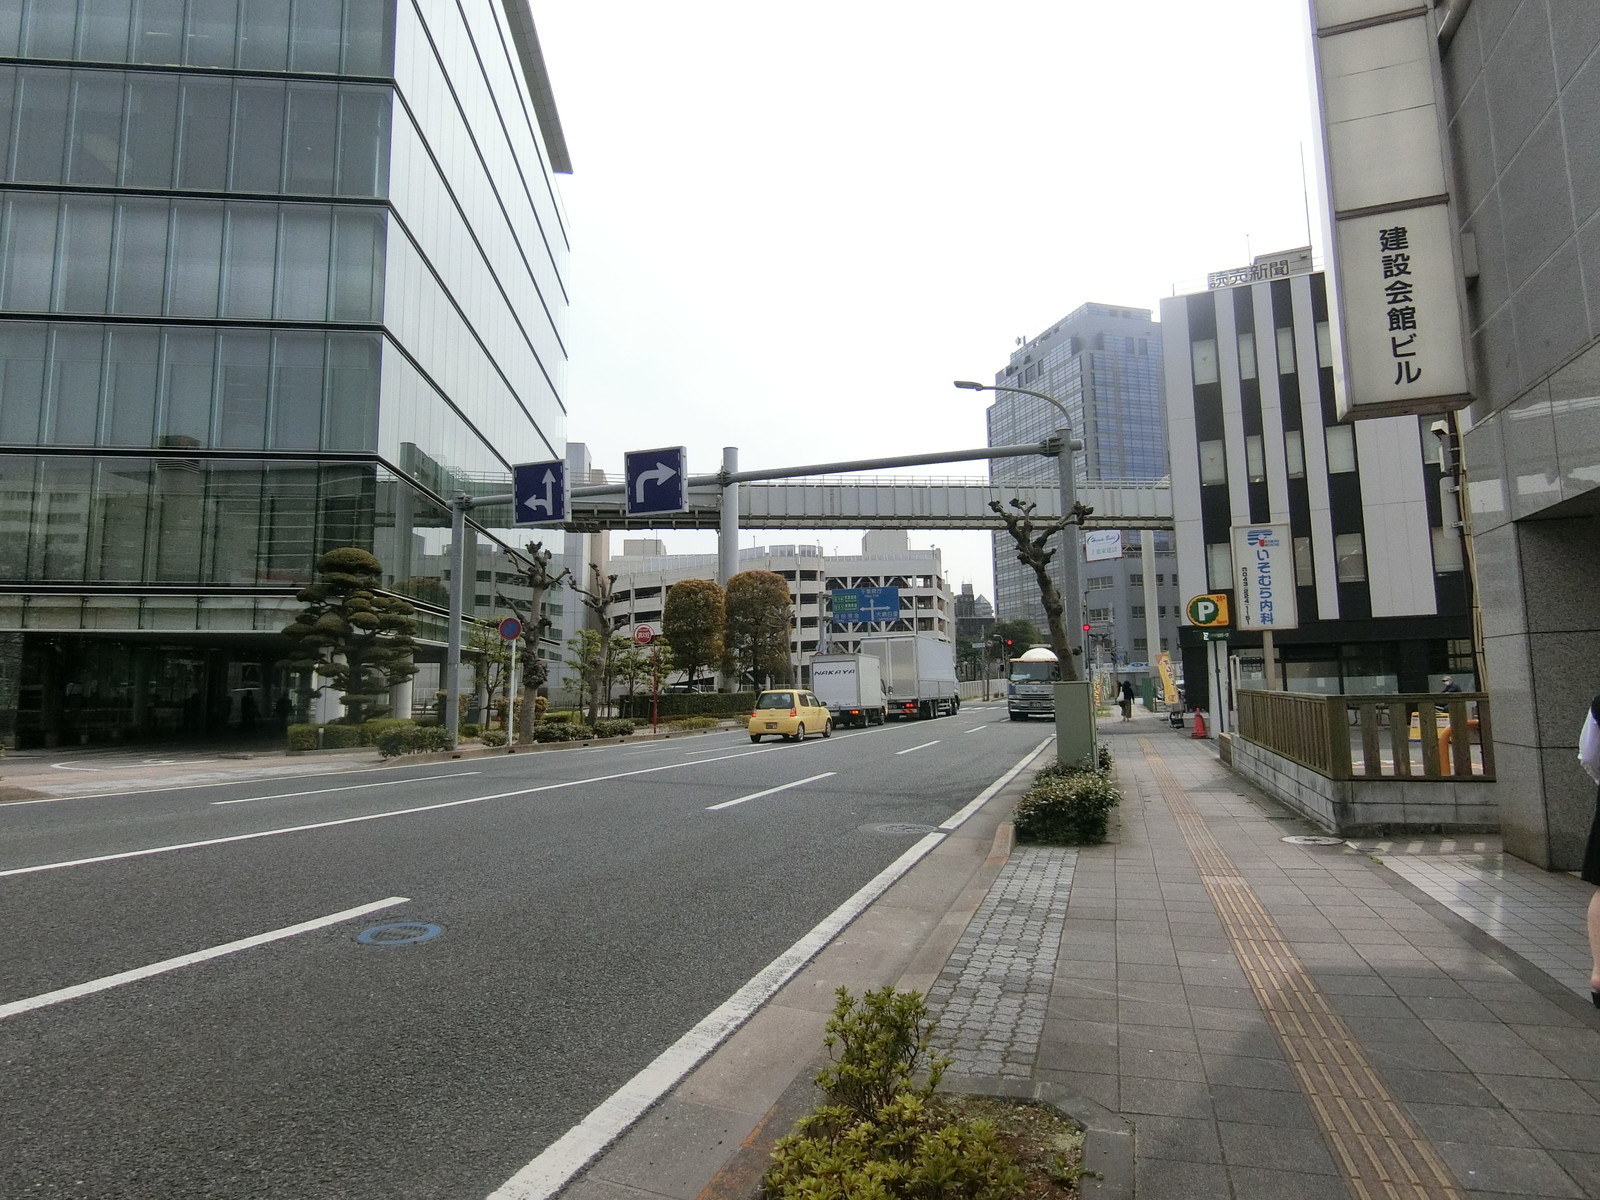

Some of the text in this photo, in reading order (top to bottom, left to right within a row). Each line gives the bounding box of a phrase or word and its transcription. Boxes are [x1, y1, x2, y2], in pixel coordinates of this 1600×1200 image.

[1209, 259, 1290, 289] 読売新聞
[1379, 226, 1422, 386] 建設会館ビル
[1197, 601, 1215, 622] P
